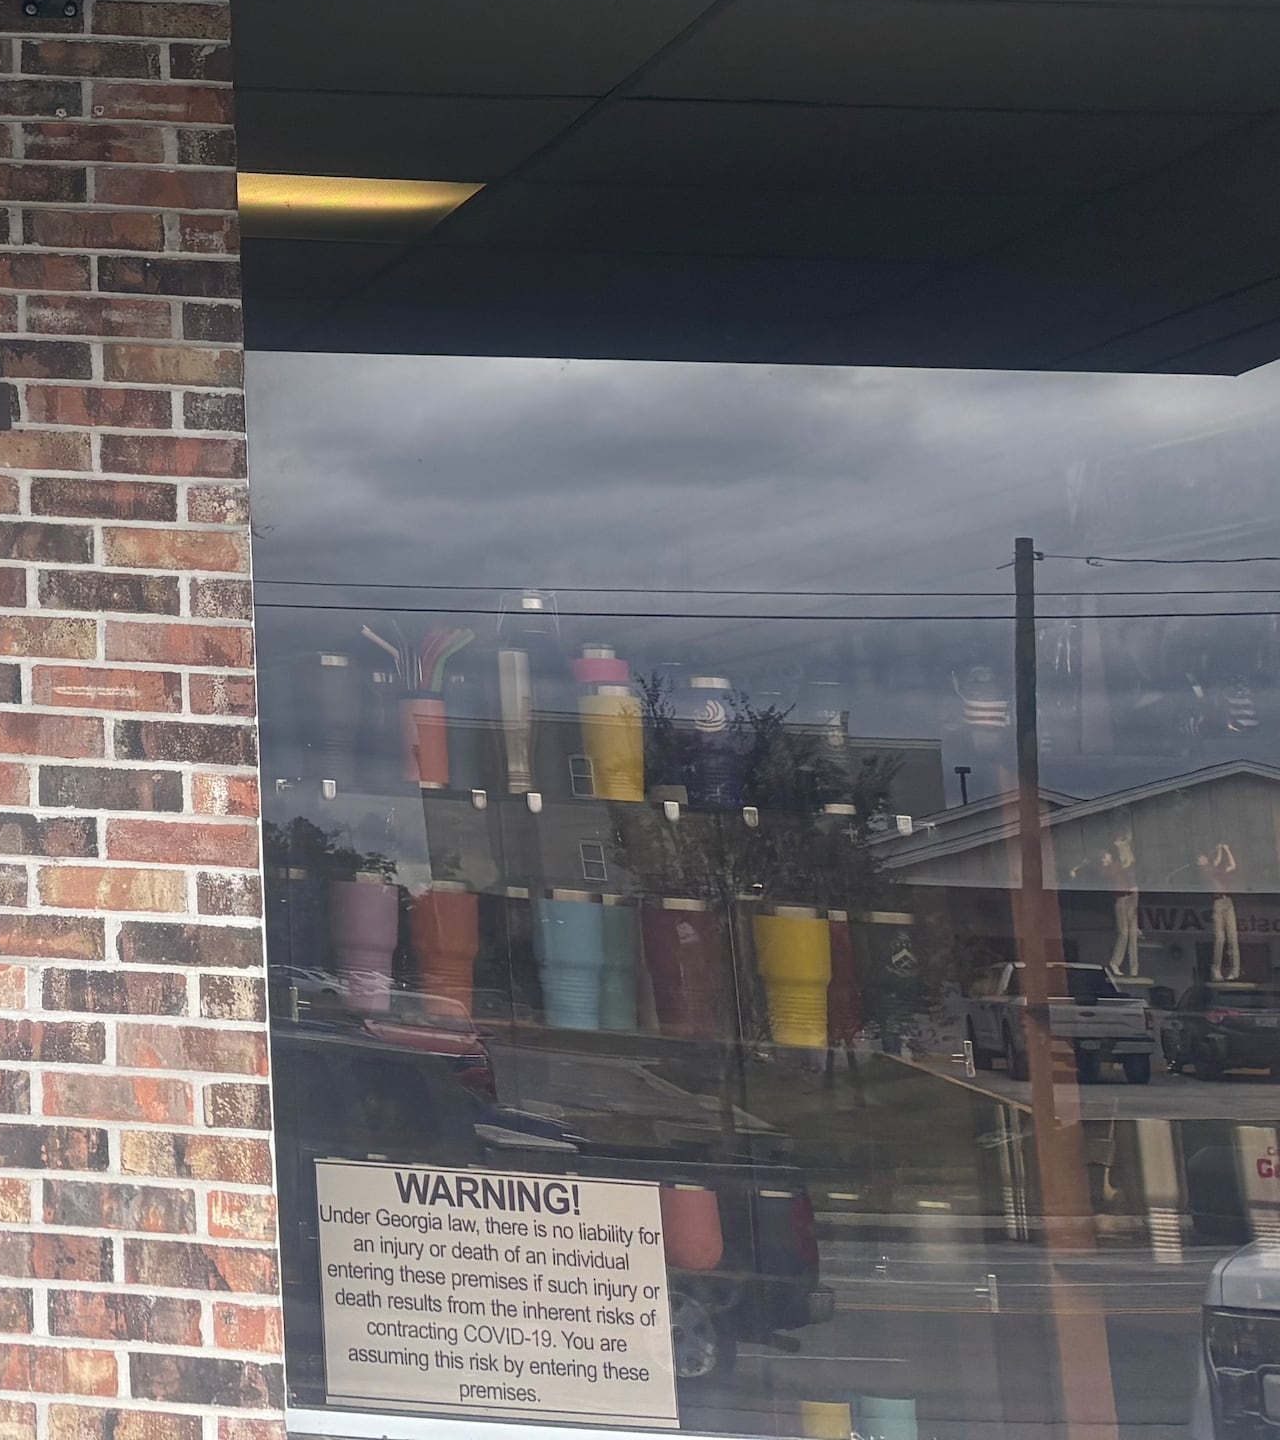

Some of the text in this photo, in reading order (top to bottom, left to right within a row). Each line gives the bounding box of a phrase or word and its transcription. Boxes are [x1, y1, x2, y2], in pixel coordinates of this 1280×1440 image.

[395, 1172, 580, 1216] WARNING!
[320, 1204, 660, 1247] Under Georgia law, there is no liability for
[353, 1236, 629, 1270] an injury or death of an individual
[328, 1263, 660, 1302] entering these premises if such injury or
[335, 1289, 656, 1327] death results from the inherent risks of
[367, 1320, 627, 1352] contracting COVID-19. You are
[348, 1347, 649, 1382] assuming this risk by entering these
[460, 1382, 541, 1402] premises.
